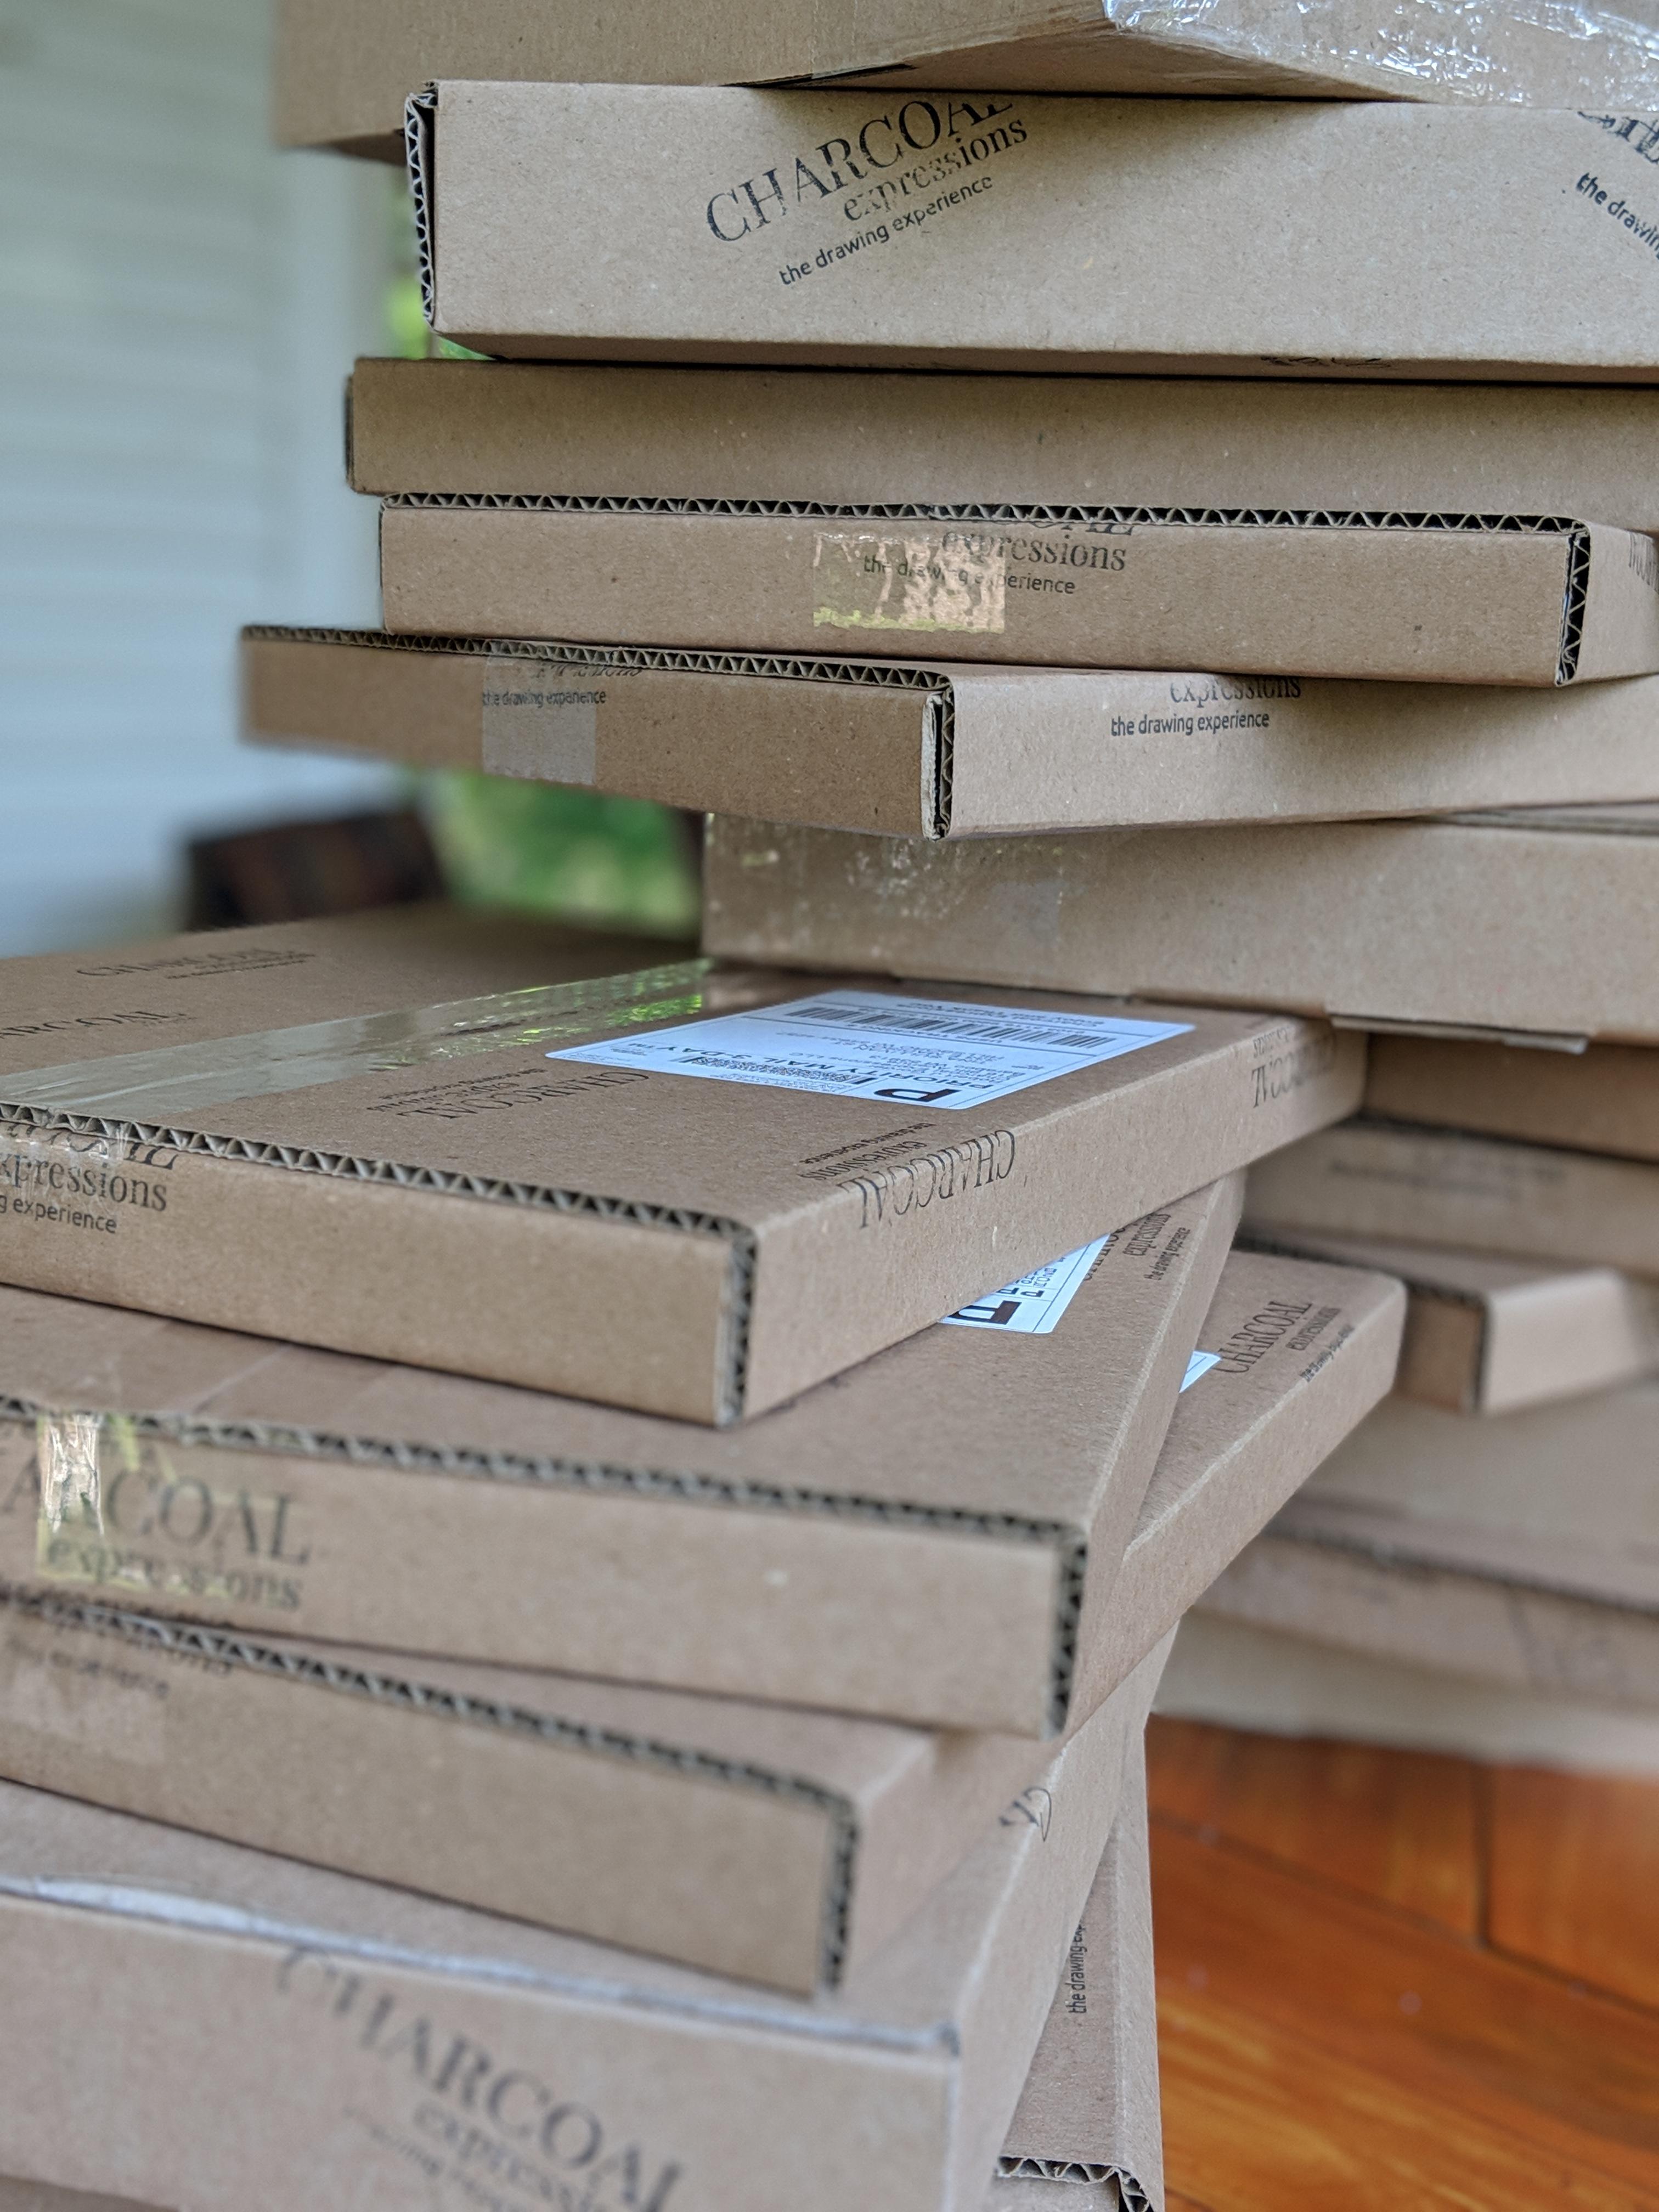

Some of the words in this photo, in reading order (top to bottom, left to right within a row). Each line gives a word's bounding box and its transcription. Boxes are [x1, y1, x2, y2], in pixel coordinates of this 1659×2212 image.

[843, 118, 1028, 221] expressions
[1576, 172, 1608, 206] the
[780, 260, 812, 285] the
[815, 225, 890, 269] drawing
[892, 174, 994, 232] experience
[1111, 716, 1135, 737] the
[1138, 714, 1194, 736] drawing
[1198, 710, 1269, 734] experience
[874, 1088, 962, 1102] P
[836, 1130, 1015, 1228] CHARCOAL
[13, 1198, 117, 1234] experience
[1064, 1945, 1088, 1991] drawing
[1069, 1993, 1087, 2014] the
